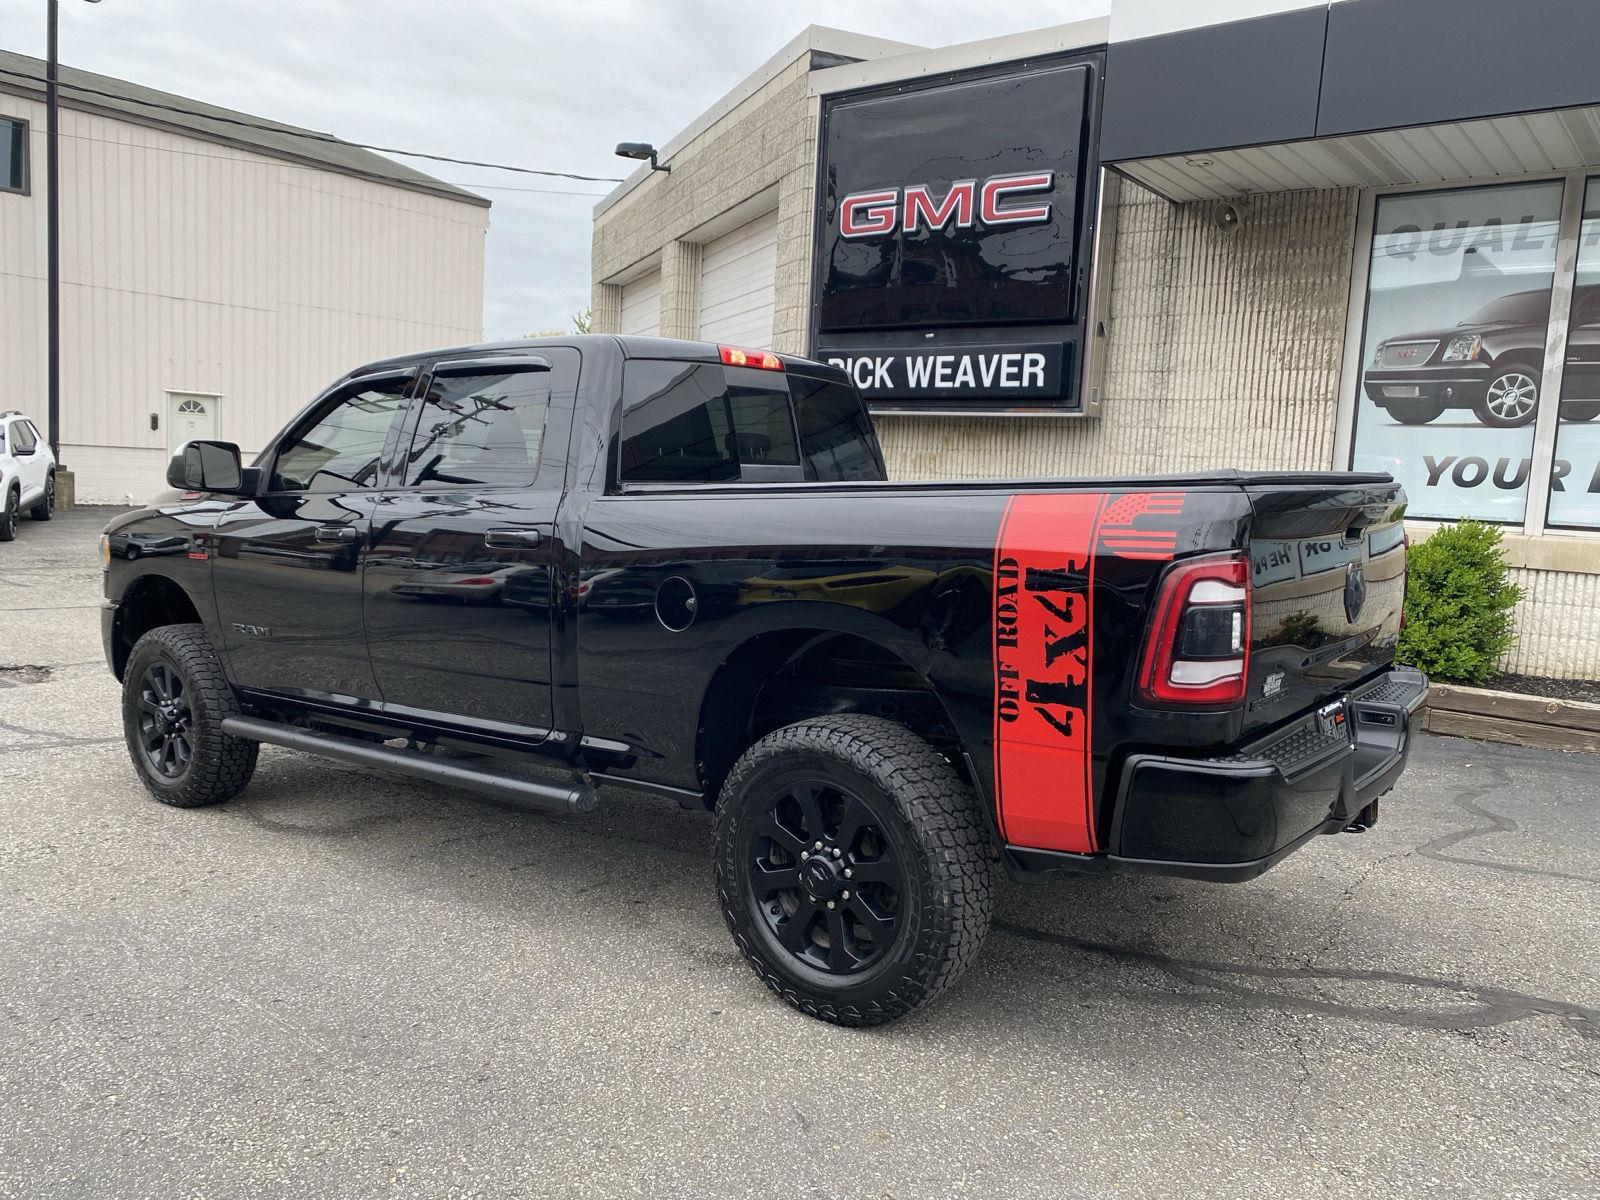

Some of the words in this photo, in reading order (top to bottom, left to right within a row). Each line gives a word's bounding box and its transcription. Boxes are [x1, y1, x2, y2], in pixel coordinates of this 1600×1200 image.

[840, 170, 1055, 238] GMC
[905, 353, 1046, 389] WEAVER
[997, 557, 1020, 649] ROAD
[1000, 661, 1020, 723] OFF
